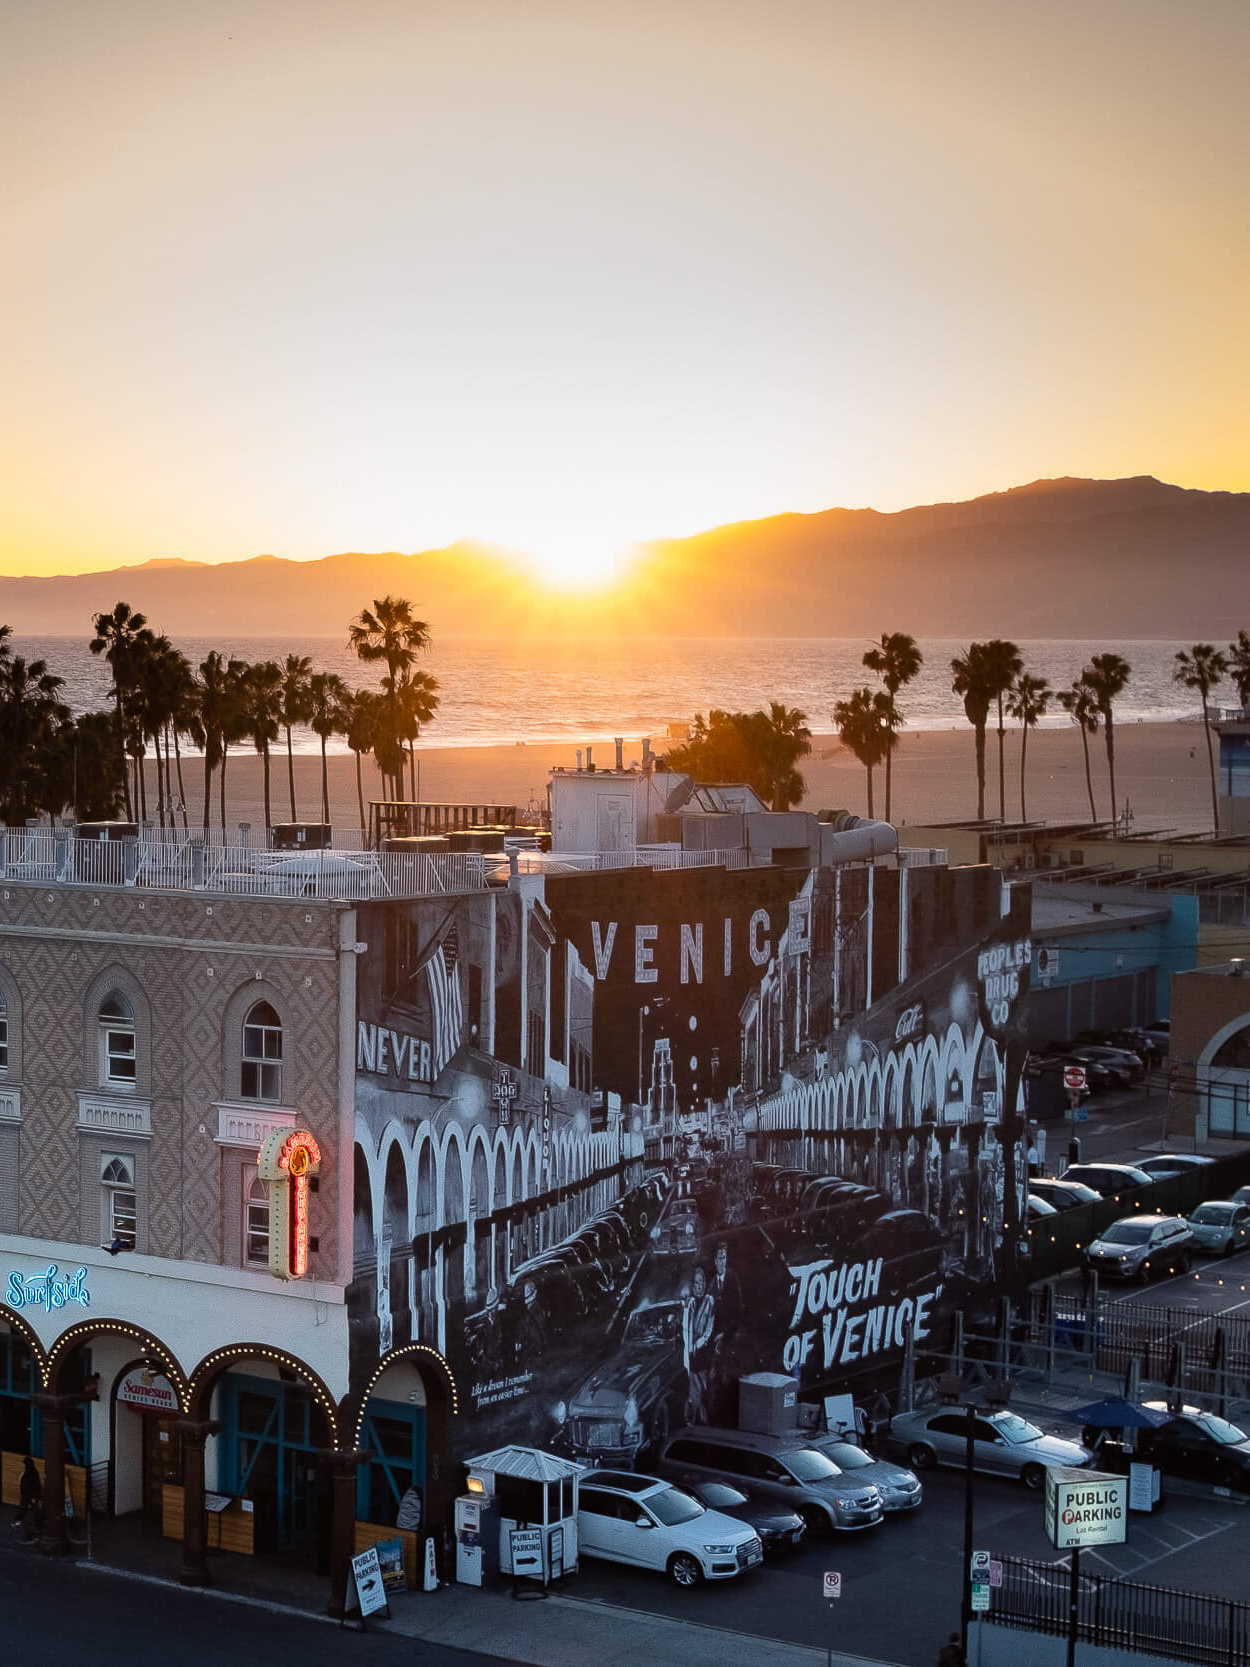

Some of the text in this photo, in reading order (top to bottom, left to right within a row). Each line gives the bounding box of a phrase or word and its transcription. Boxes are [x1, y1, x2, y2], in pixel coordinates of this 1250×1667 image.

[590, 899, 811, 984] VENICE
[977, 940, 1031, 980] PEOPLES
[985, 971, 1019, 1001] DRUG
[991, 1000, 1009, 1027] CO
[357, 1020, 431, 1083] NEVER
[6, 1264, 90, 1312] Surfside
[783, 1329, 817, 1371] OF
[124, 1380, 172, 1401] Samesun
[1066, 1490, 1119, 1508] PUBLIC
[1061, 1507, 1122, 1525] PARKING
[512, 1533, 540, 1542] PUBLIC
[1066, 1538, 1081, 1546] ATM
[513, 1544, 541, 1553] PARKING
[354, 1552, 376, 1569] PUBLIC
[356, 1563, 380, 1580] PARKING
